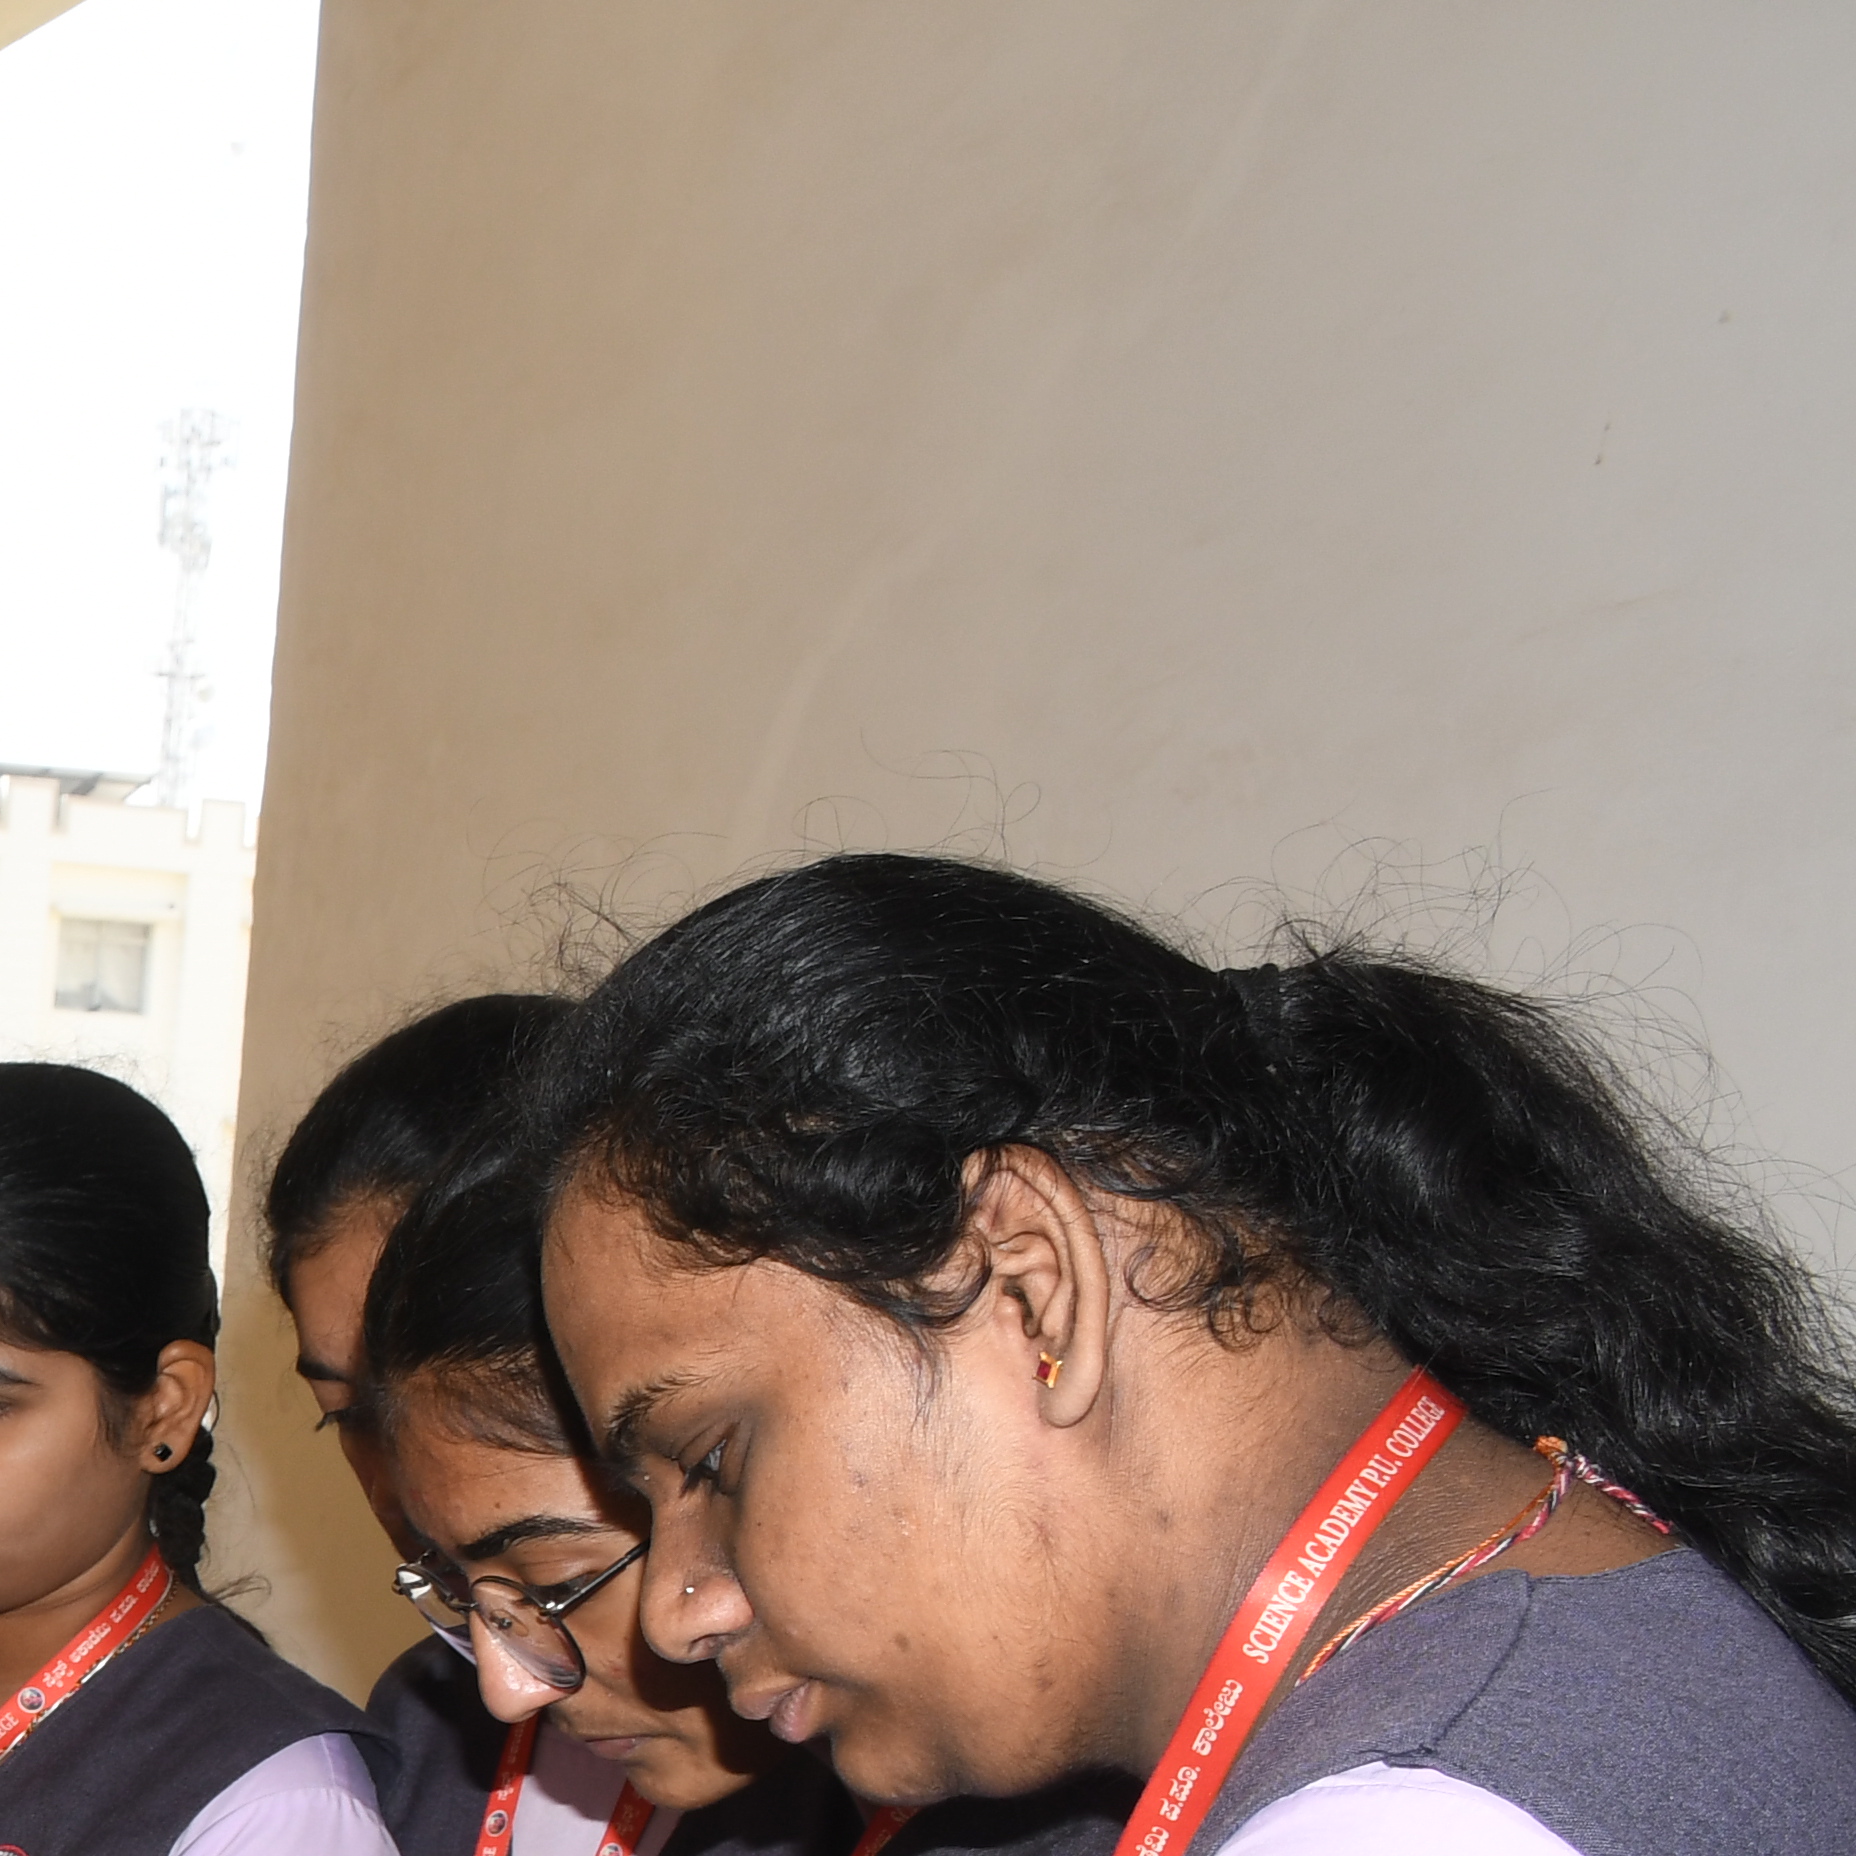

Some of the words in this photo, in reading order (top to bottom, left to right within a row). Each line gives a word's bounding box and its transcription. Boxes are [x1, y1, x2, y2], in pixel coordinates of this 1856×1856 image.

[1242, 1569, 1316, 1665] SCIENCE
[1297, 1477, 1380, 1580] ACADEMY
[1358, 1452, 1405, 1490] P.U.
[1384, 1394, 1448, 1459] COLLEGE
[1191, 1678, 1245, 1758] ಕಾಲೇಜು
